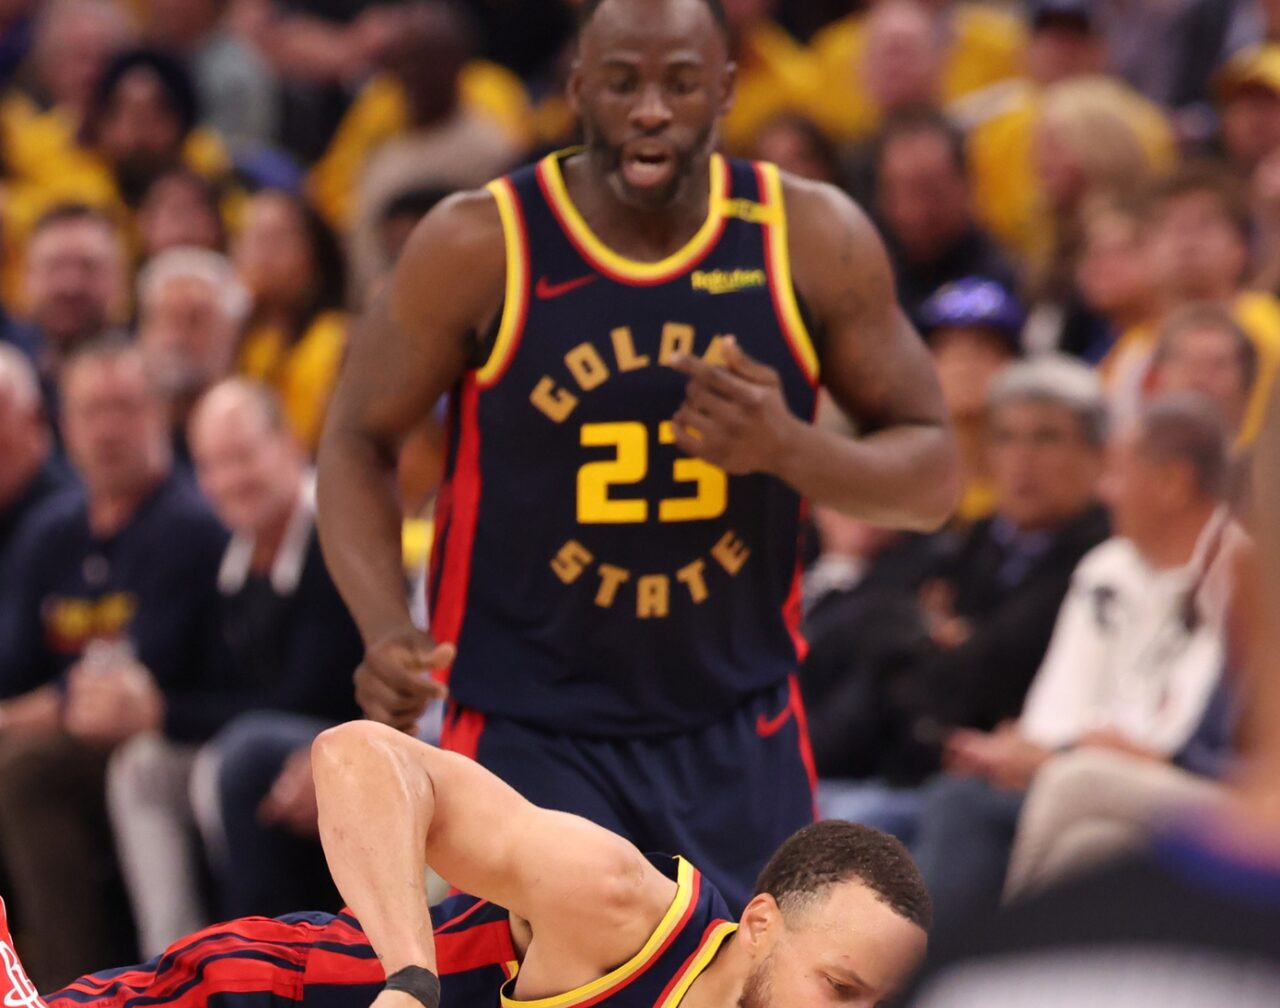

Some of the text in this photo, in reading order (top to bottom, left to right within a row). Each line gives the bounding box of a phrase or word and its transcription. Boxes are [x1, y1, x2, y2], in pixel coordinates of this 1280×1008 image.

[529, 321, 726, 424] GOLD
[577, 421, 728, 523] 23
[550, 530, 751, 618] STATE
